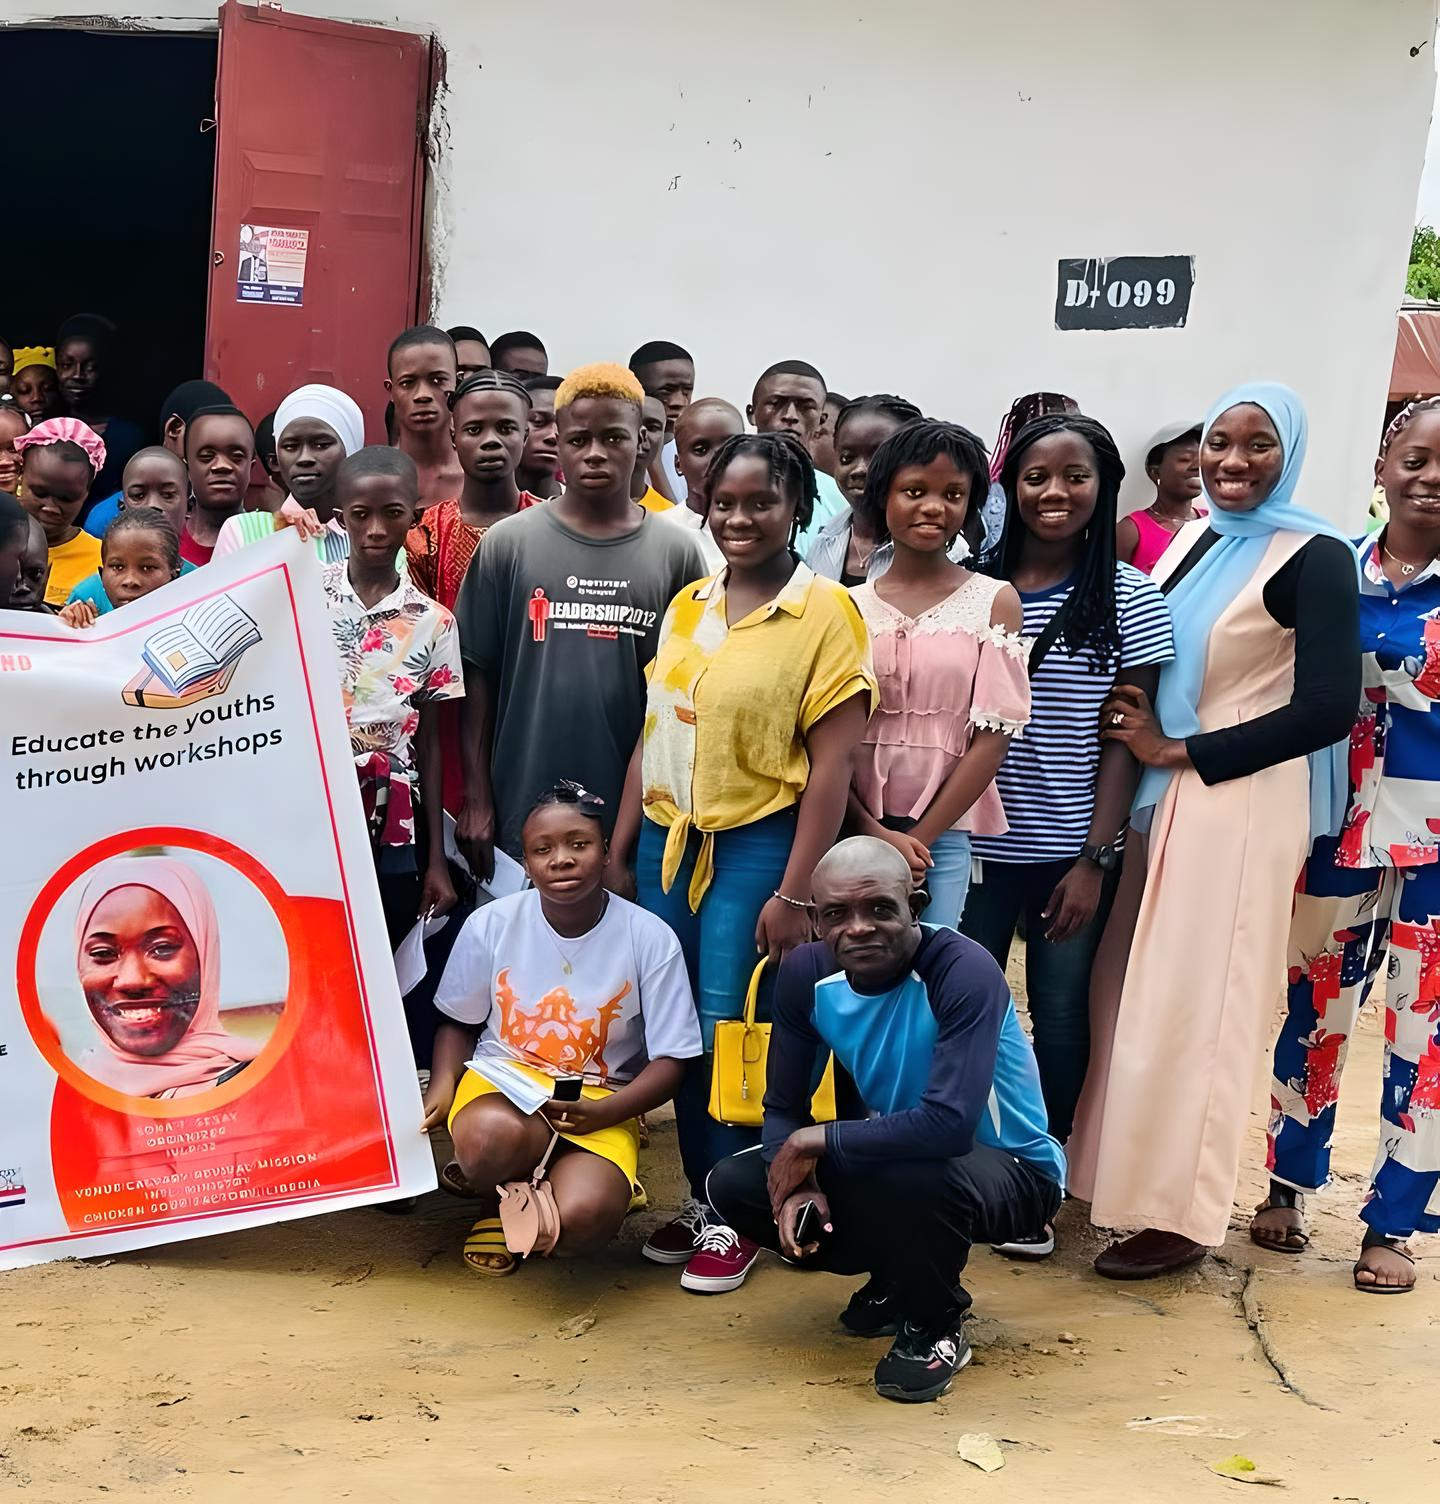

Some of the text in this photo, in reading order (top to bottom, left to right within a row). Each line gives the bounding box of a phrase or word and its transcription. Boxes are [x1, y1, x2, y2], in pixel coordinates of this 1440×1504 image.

[549, 601, 628, 623] LEADERSHIP
[11, 694, 275, 756] Educate the youths
[15, 728, 282, 790] through workshops
